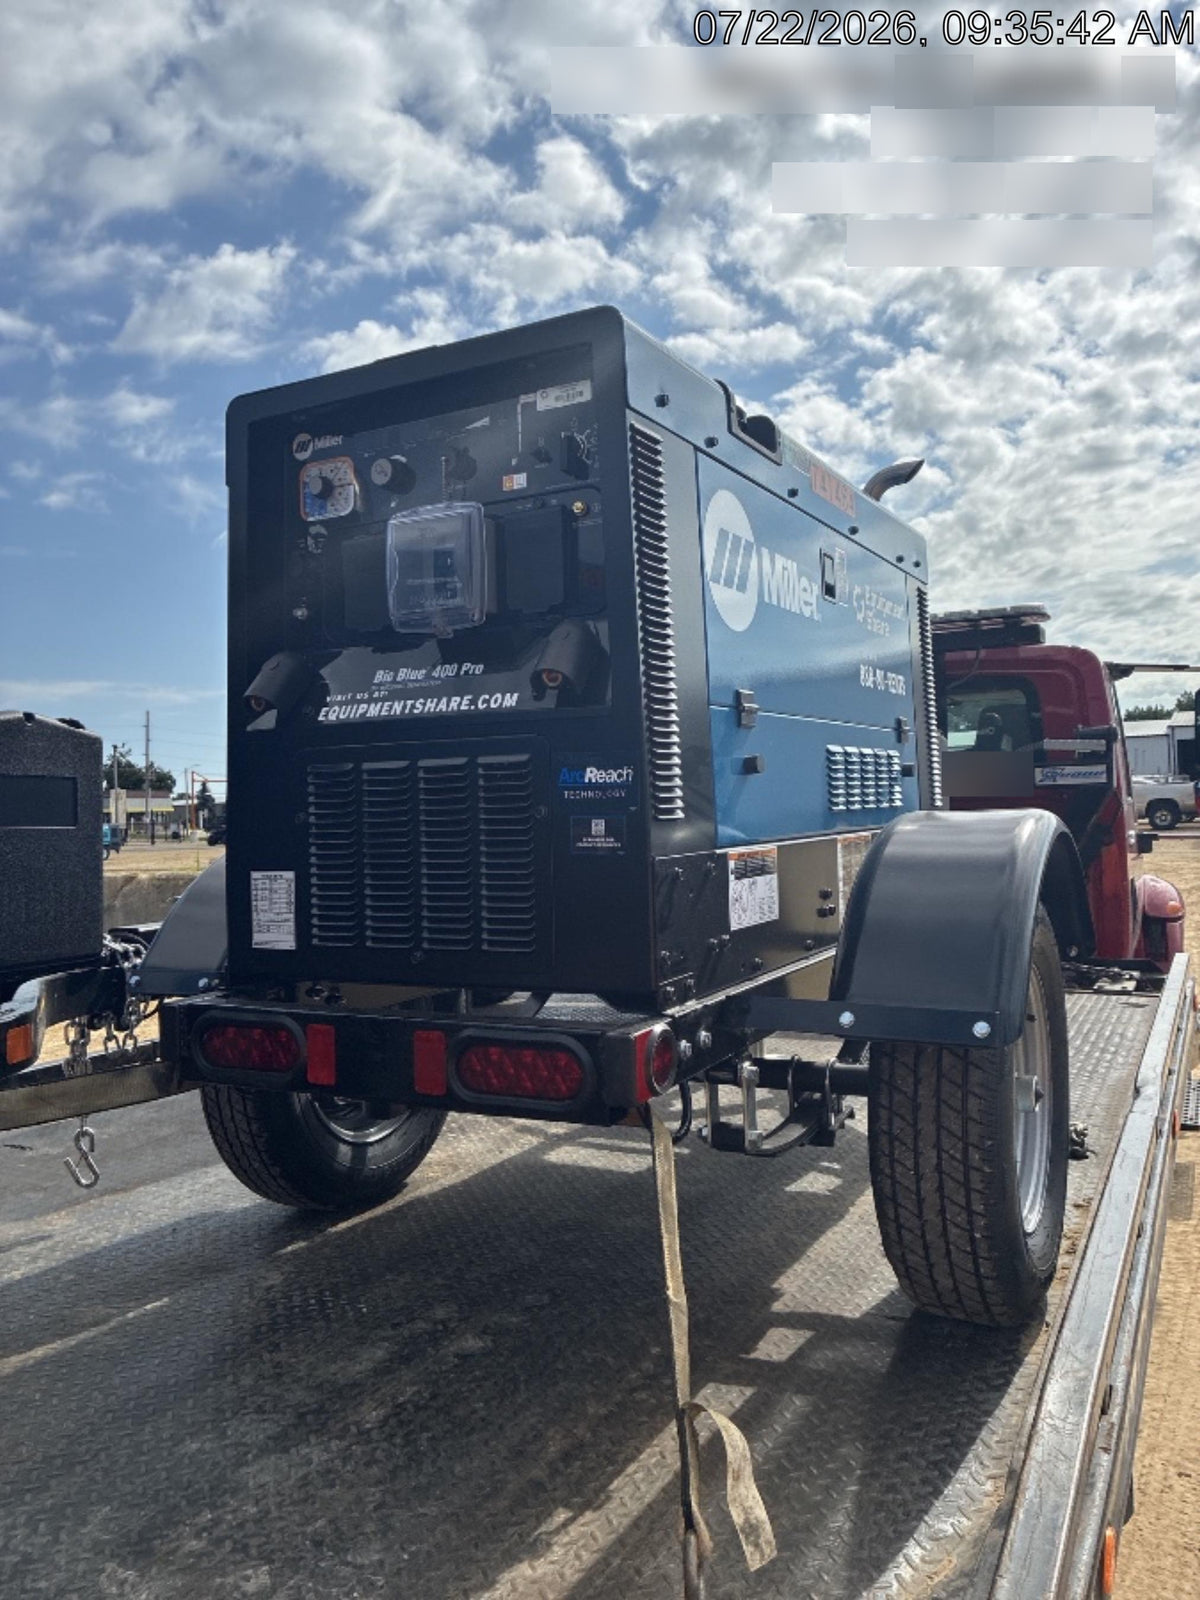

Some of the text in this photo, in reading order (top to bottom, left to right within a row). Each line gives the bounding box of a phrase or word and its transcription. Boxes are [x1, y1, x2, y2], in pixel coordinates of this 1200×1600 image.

[761, 546, 821, 621] Miller
[432, 663, 458, 679] 400
[460, 662, 485, 677] Pro
[317, 692, 520, 722] EQUIPMENTSHARE.COM
